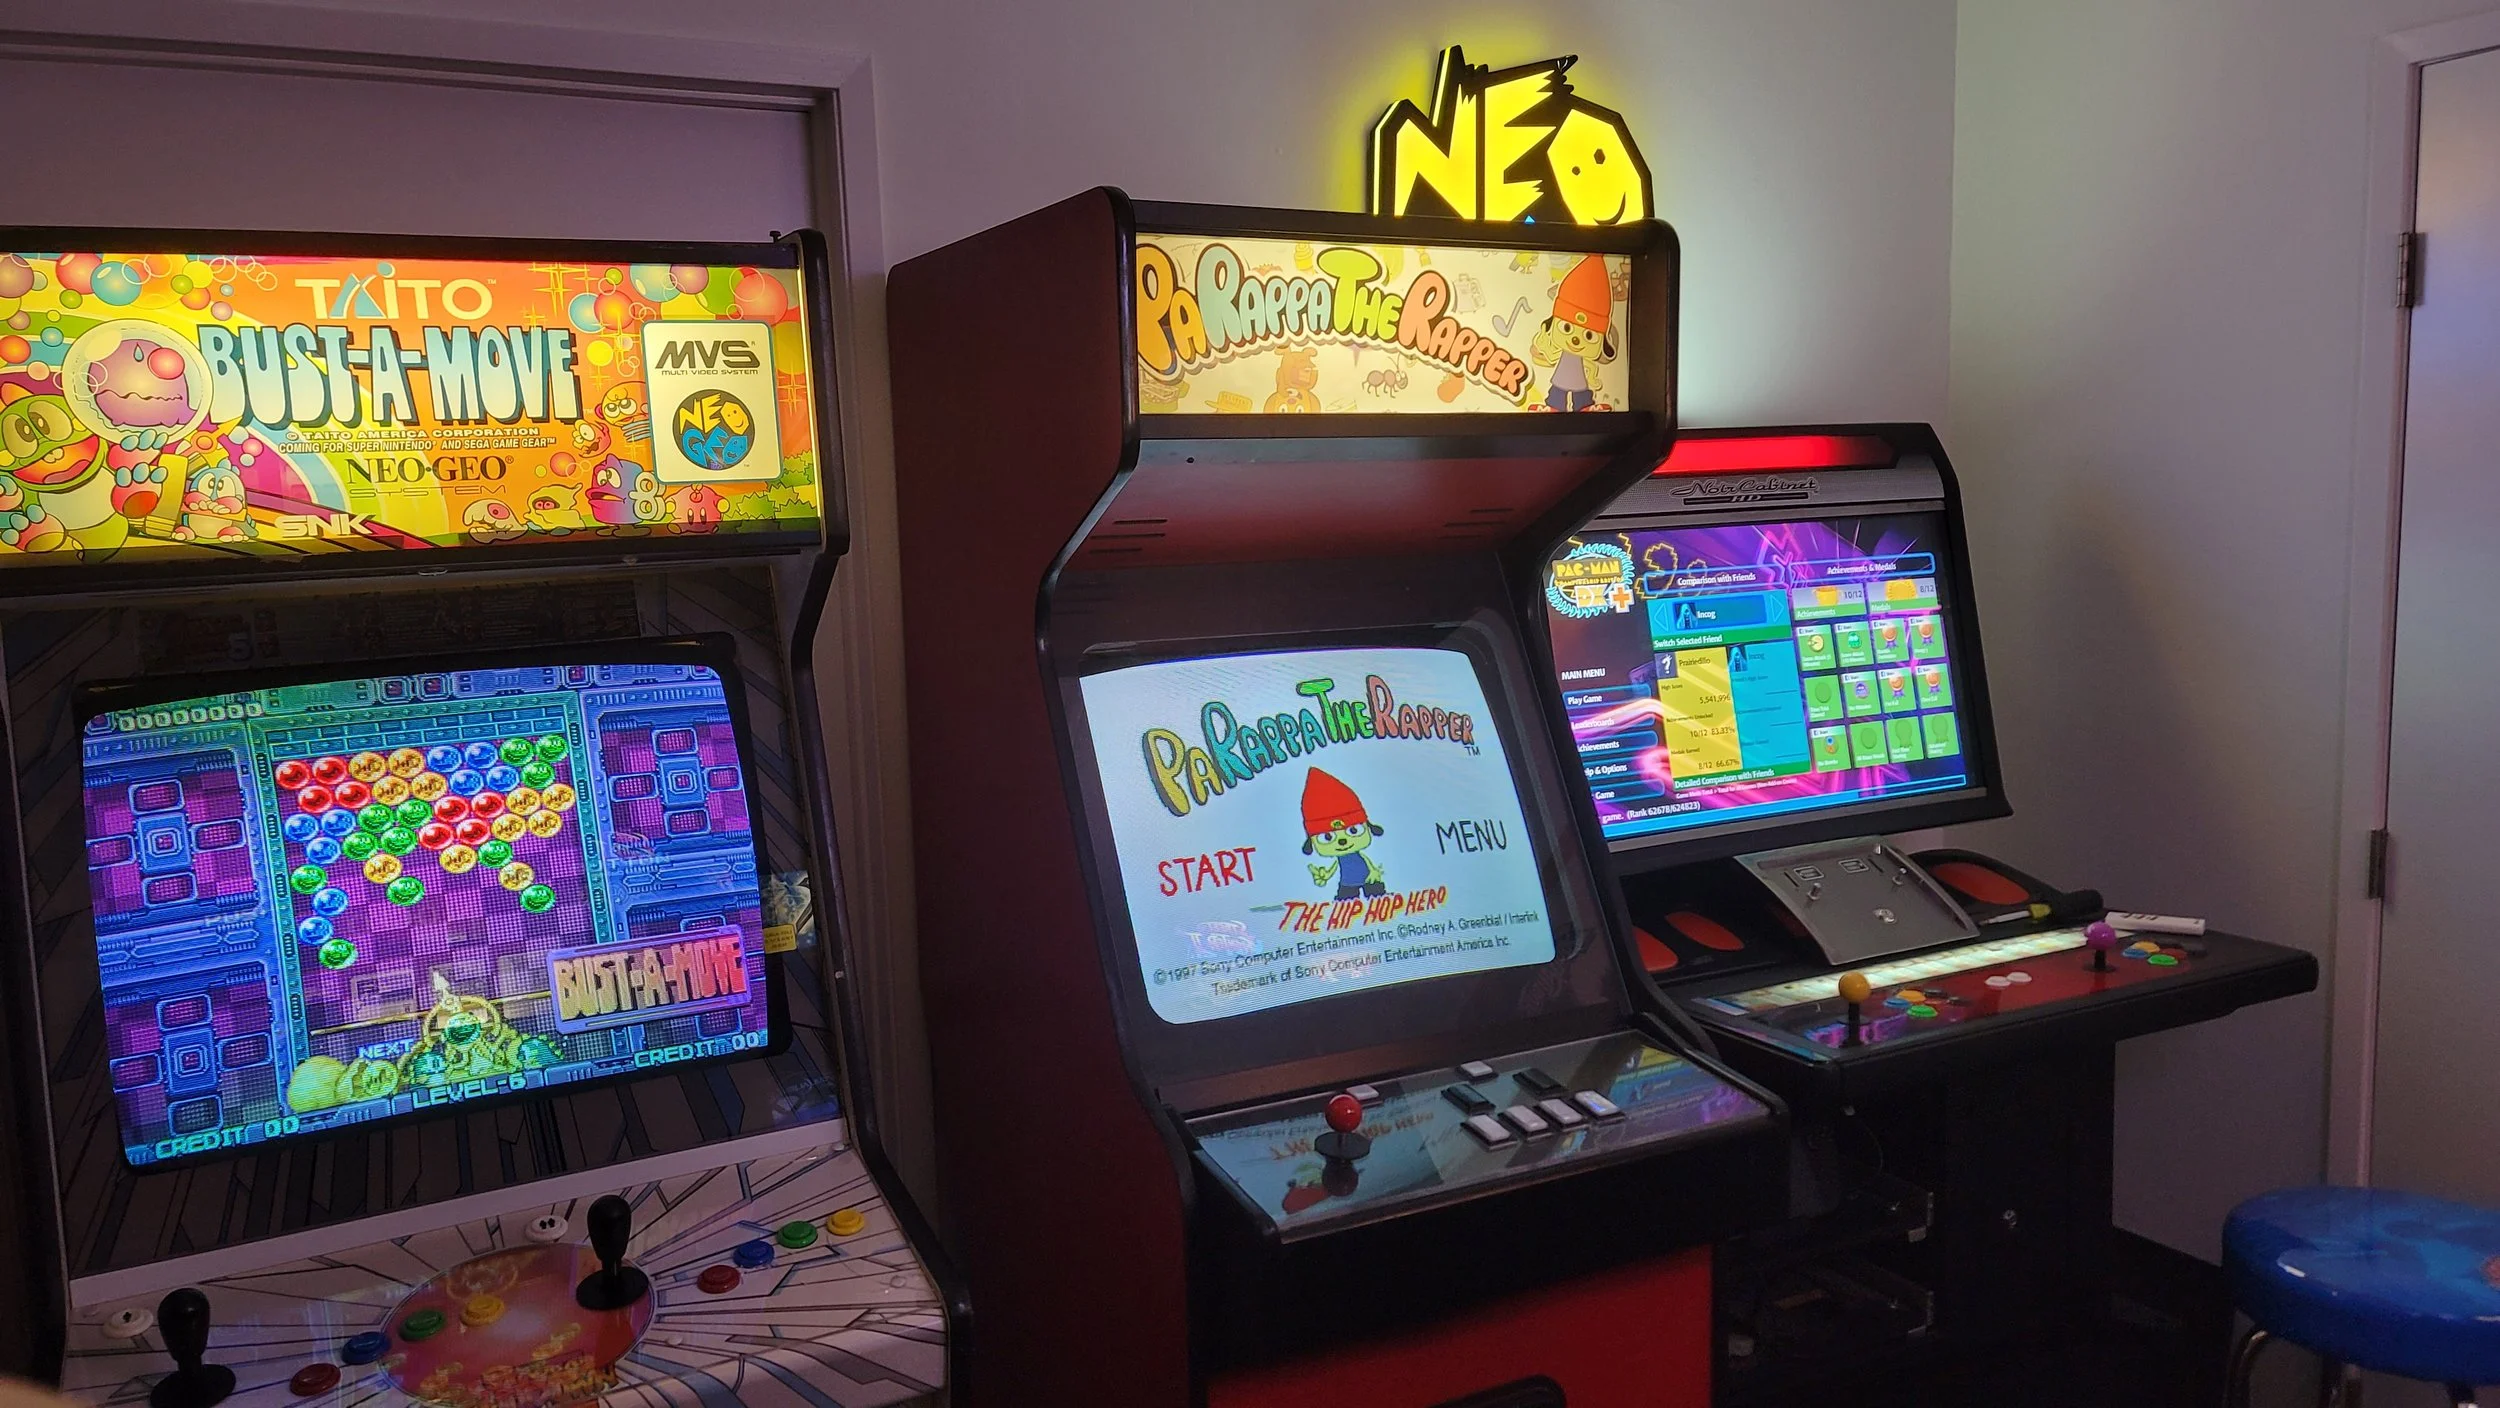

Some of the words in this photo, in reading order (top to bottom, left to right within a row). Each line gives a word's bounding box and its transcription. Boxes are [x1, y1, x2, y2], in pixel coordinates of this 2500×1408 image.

[1372, 48, 1653, 226] NEO
[295, 262, 494, 320] TAITO
[655, 340, 760, 369] MVS
[196, 322, 584, 428] BUST-A-MOVE
[679, 393, 750, 436] NEO
[302, 430, 353, 441] TAITO
[357, 429, 430, 440] AMERICA
[432, 428, 540, 438] CORPORATION
[279, 442, 321, 454] COMING
[323, 441, 345, 453] FOR
[346, 441, 381, 452] SUPER
[382, 440, 433, 451] NINTENDO
[441, 439, 463, 450] AND
[464, 439, 490, 449] SEGA
[492, 438, 519, 449] GAME
[682, 426, 748, 467] GEO
[349, 484, 508, 497] SYSTEM
[274, 513, 376, 539] SNK
[1556, 560, 1620, 577] PAC-MAN
[1826, 565, 1868, 575] Achievements
[1875, 562, 1897, 571] Medals
[1677, 575, 1716, 586] Comparison
[1717, 574, 1732, 583] with
[1733, 572, 1756, 581] Friends
[1844, 590, 1863, 599] 10/12
[1697, 611, 1716, 620] Incog
[1797, 608, 1836, 618] Achievements
[1654, 637, 1676, 648] Switch
[1676, 636, 1702, 647] Selected
[1702, 634, 1723, 644] Friend
[1561, 670, 1583, 681] MAIN
[1583, 668, 1606, 679] MENU
[1568, 696, 1583, 706] Play
[1583, 694, 1603, 704] Game
[1571, 718, 1615, 730] Leaderboards
[1578, 741, 1619, 752] chievements
[1601, 764, 1628, 775] Options
[1674, 779, 1701, 789] Detailed
[1701, 775, 1738, 787] Comparison
[1738, 772, 1752, 780] with
[1752, 769, 1775, 778] Friends
[1595, 791, 1615, 799] Game
[1435, 819, 1508, 855] MENU
[1158, 847, 1257, 897] START
[1279, 901, 1330, 933] THE
[1327, 898, 1364, 932] HIP
[1363, 892, 1404, 927] HOP
[1405, 885, 1448, 917] HERO
[1201, 960, 1233, 976] Sony
[1235, 947, 1294, 969] Computer
[1297, 931, 1375, 956] Entertainment
[553, 932, 747, 1021] BUST-A-MOVE
[1211, 971, 1278, 996] Trademark
[1280, 968, 1293, 982] of
[1295, 964, 1326, 980] Sony
[1328, 953, 1381, 972] Computer
[1384, 944, 1455, 963] Entertainment
[1457, 937, 1494, 951] America
[358, 1037, 415, 1061] NEXT
[634, 1040, 716, 1068] CREDIT
[732, 1032, 760, 1051] 00
[155, 1127, 247, 1160] CREDIT
[264, 1115, 300, 1138] 00
